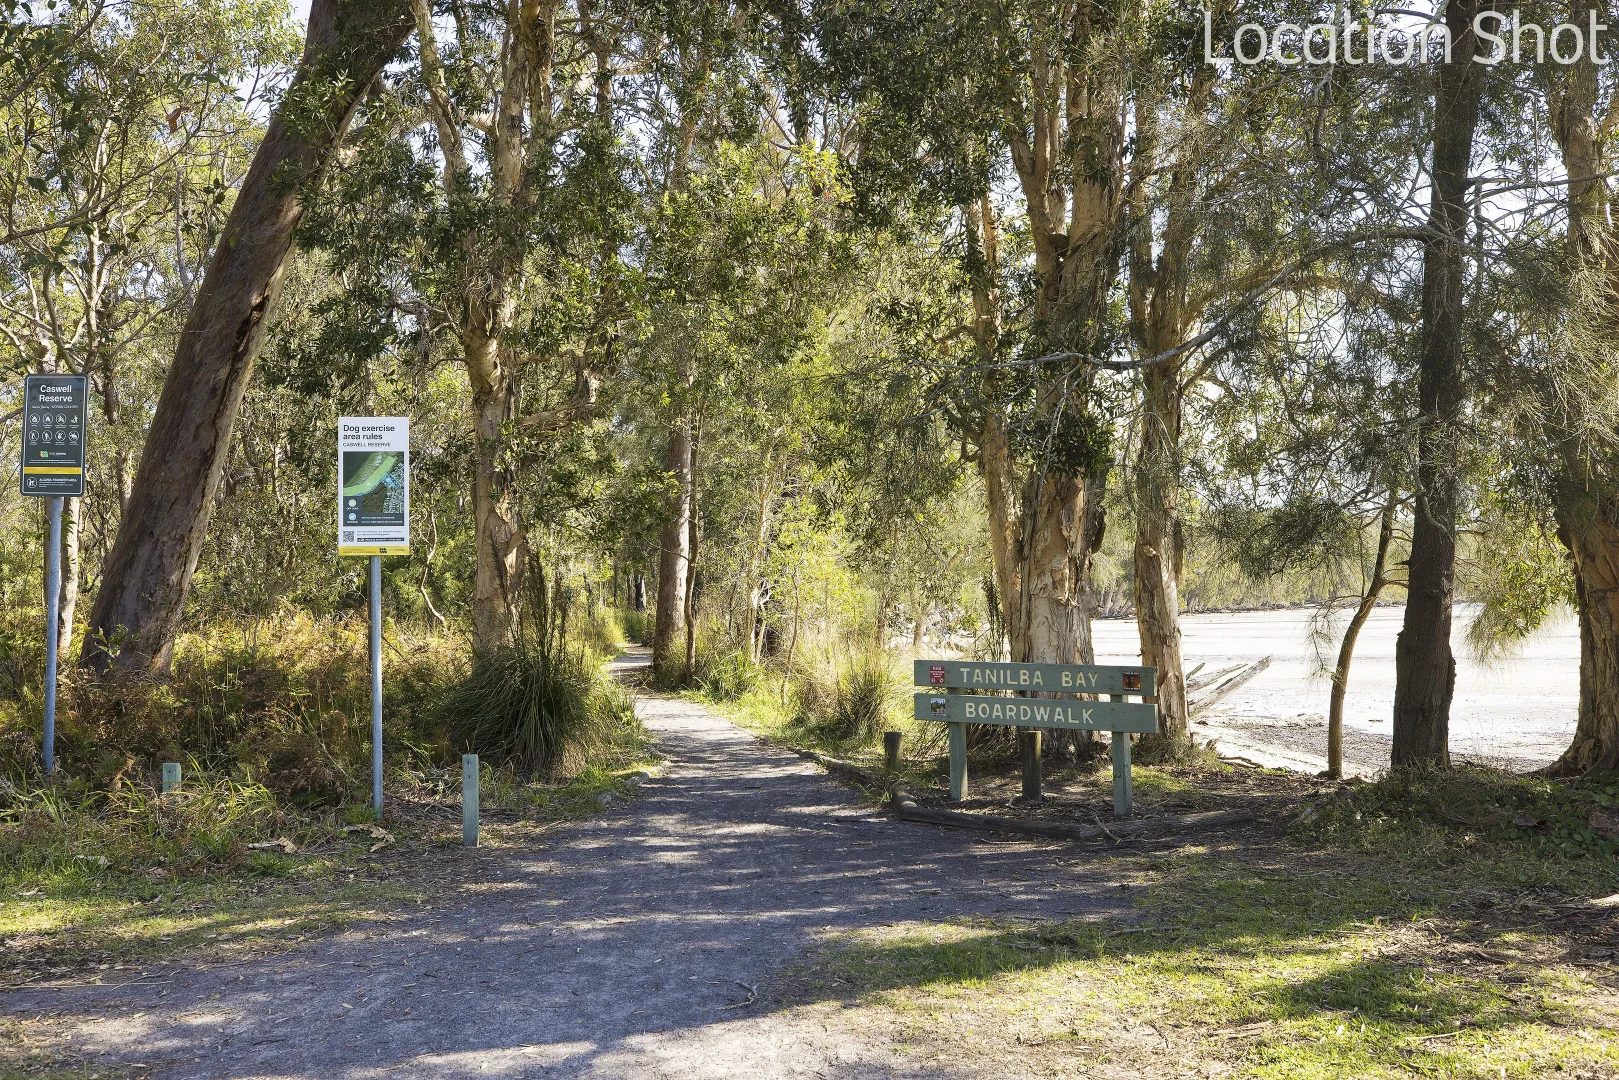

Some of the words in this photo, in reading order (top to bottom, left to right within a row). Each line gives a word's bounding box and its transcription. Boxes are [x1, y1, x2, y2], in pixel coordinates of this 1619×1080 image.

[40, 384, 72, 393] Caswell
[39, 394, 73, 402] Reserve
[343, 424, 360, 433] Dog
[361, 424, 396, 432] exercise
[362, 432, 383, 440] rules
[960, 667, 1044, 686] TANILBA
[1061, 670, 1099, 688] BAY
[965, 702, 1094, 724] BOARDWALK
